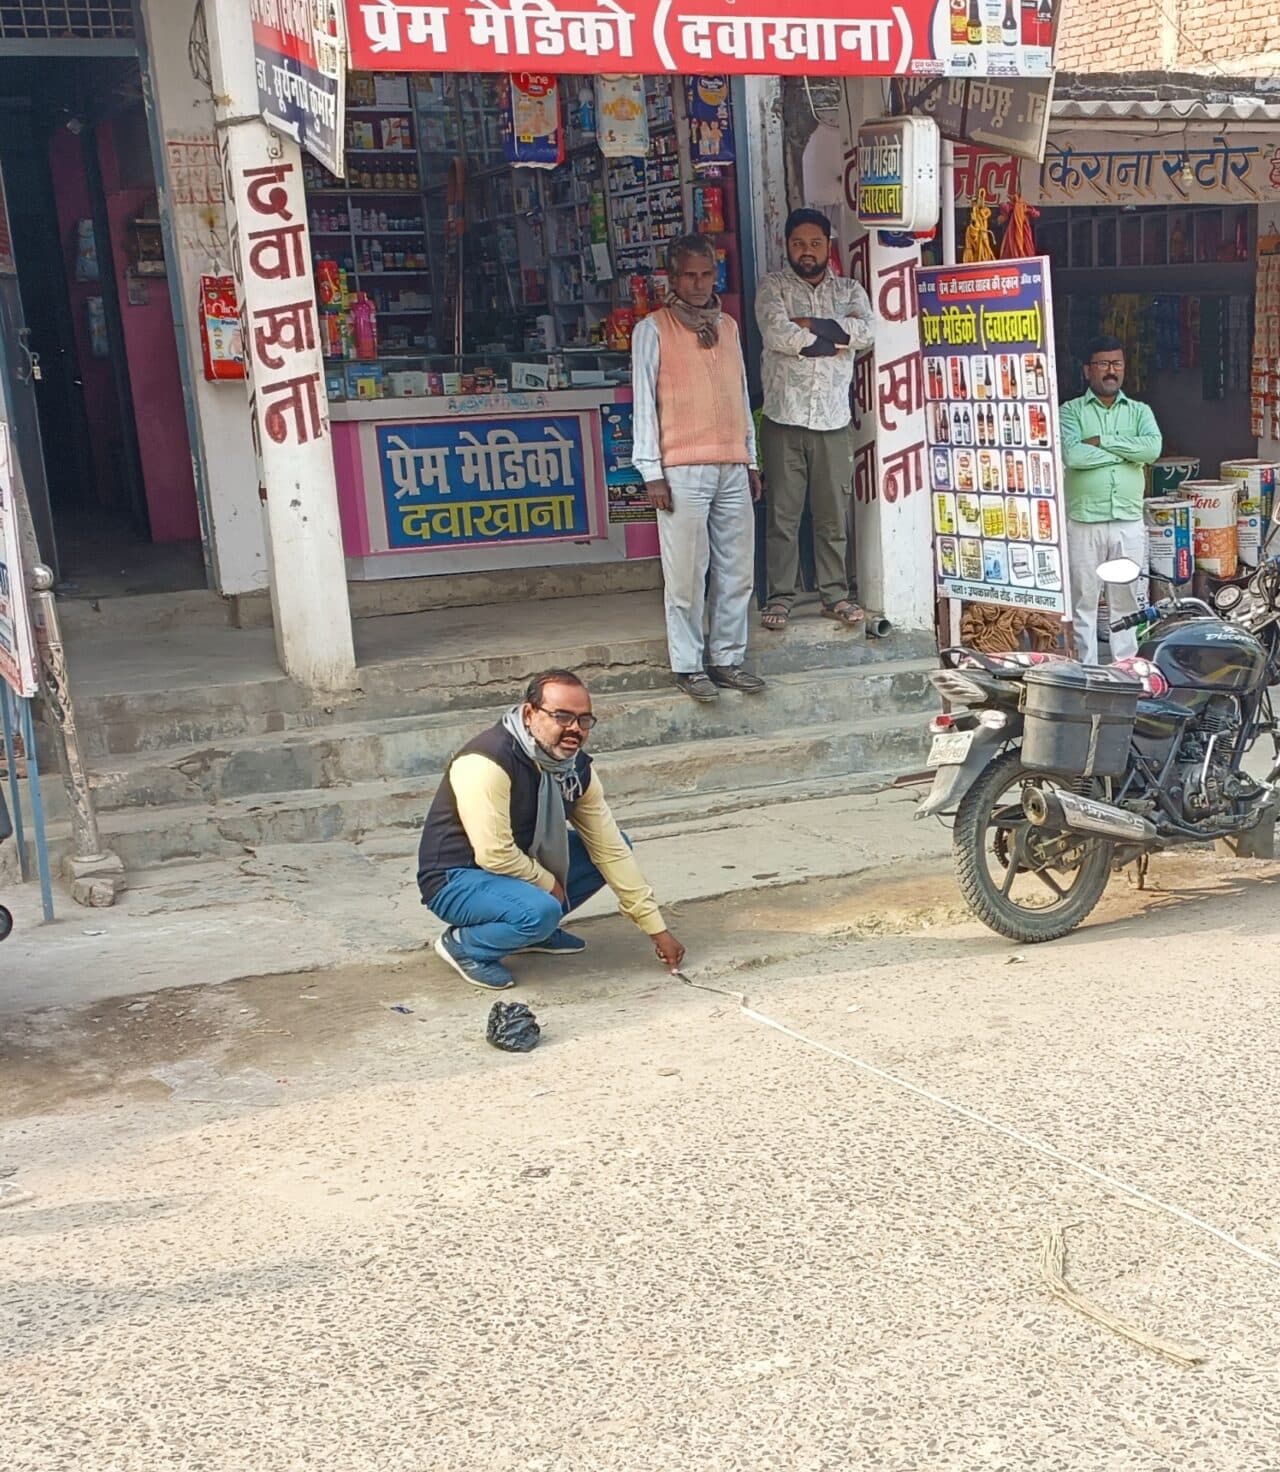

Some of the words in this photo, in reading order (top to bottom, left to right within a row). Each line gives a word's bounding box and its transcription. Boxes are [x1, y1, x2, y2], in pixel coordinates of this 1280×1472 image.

[360, 0, 449, 53] प्रेम
[465, 0, 636, 57] मेडिको
[921, 307, 941, 347] प्रेम
[942, 303, 977, 345] मेडिको
[387, 435, 450, 499] प्रेम
[455, 426, 575, 491] मेडिको
[398, 495, 575, 540] दवाखाना
